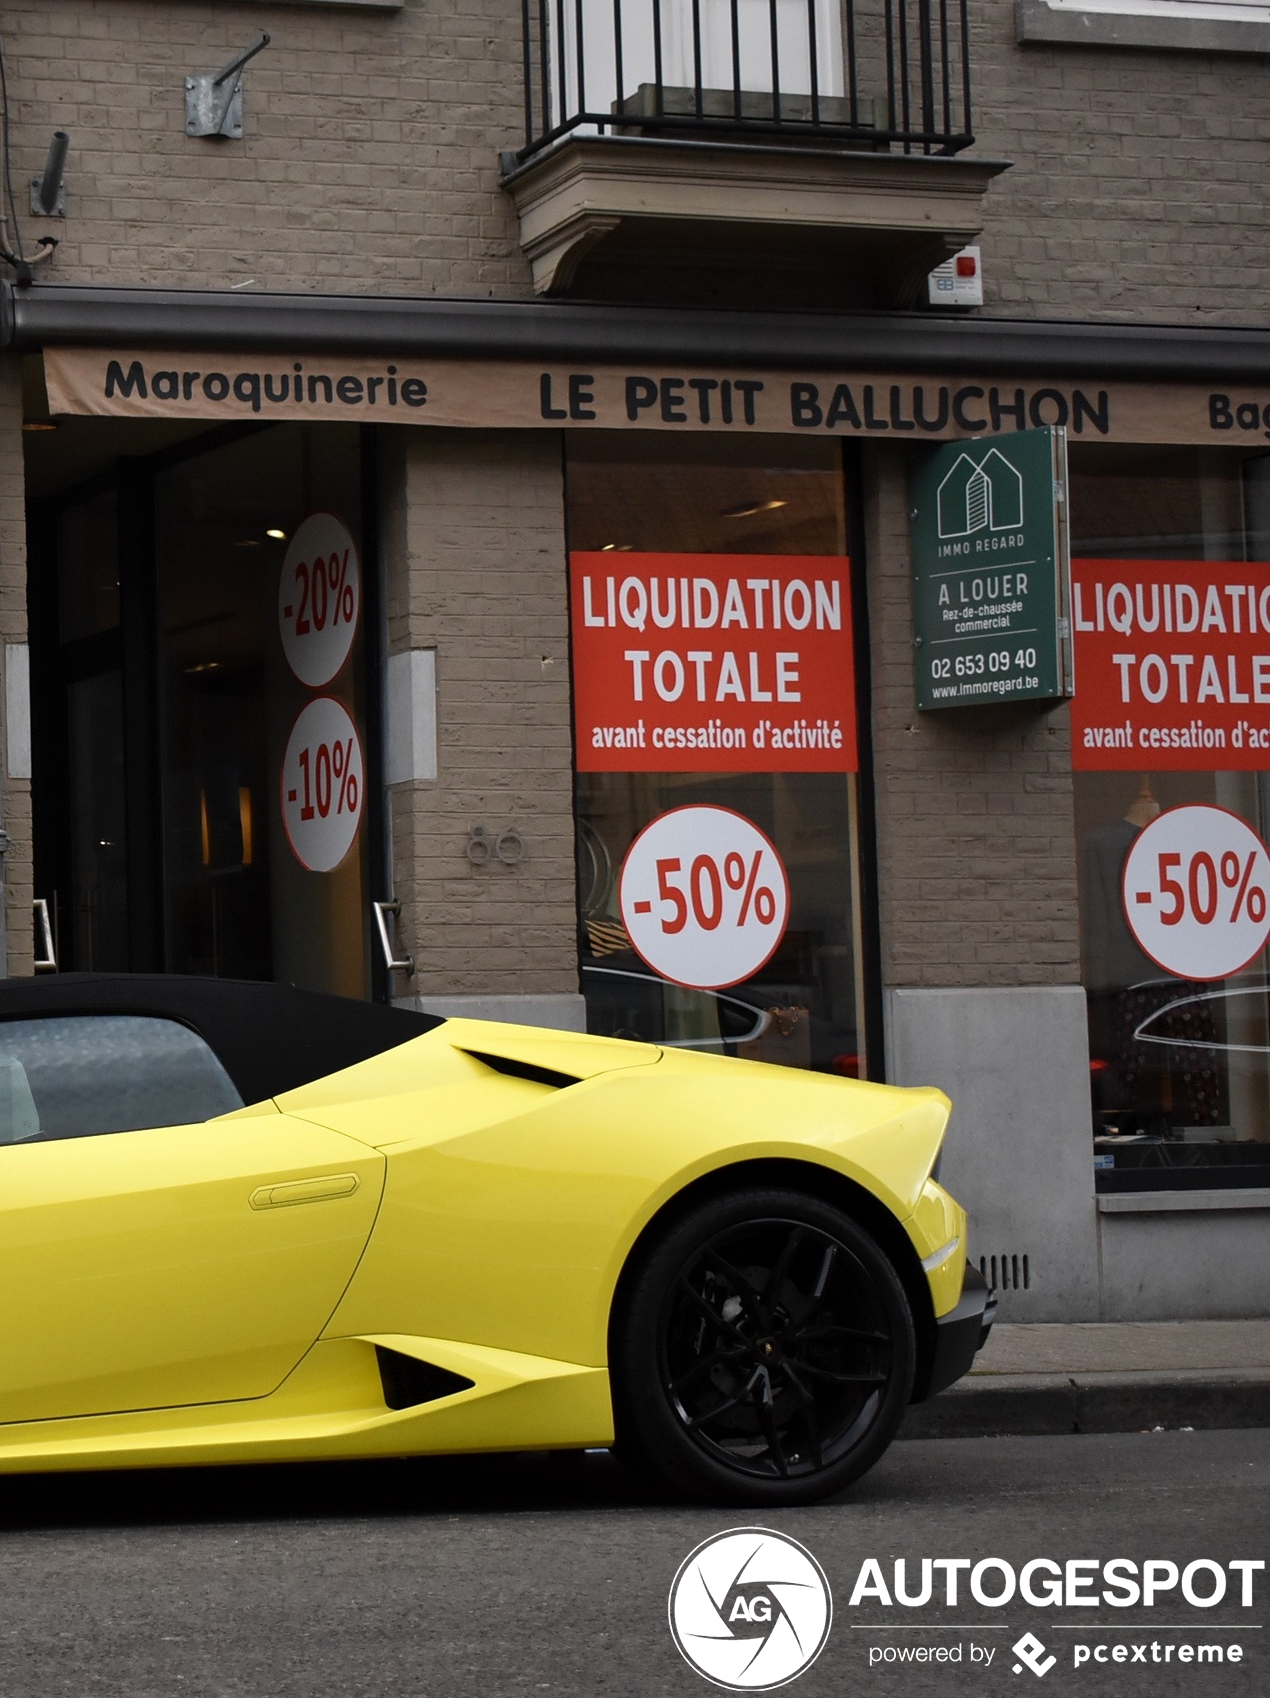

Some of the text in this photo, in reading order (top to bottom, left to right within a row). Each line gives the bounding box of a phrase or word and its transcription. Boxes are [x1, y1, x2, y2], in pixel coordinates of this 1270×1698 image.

[104, 360, 428, 412] Maroquinerie
[540, 372, 1109, 435] LE PETIT BALLUCHON
[938, 534, 1025, 558] IMMO REGARD
[283, 548, 355, 638] -20%
[582, 575, 842, 632] LIQUIDATION
[938, 573, 1029, 605] A LOUER
[942, 600, 1023, 621] Rez-de-chaussée
[955, 616, 1011, 634] commercial
[625, 650, 801, 702] TOTALE
[931, 648, 1037, 679] 02 653 09 40
[932, 675, 1039, 699] www.immoregard.be
[1112, 653, 1270, 704] TOTALE
[592, 718, 843, 750] avant cessation d'activité
[1083, 720, 1270, 749] avant cessation d'ac
[287, 738, 358, 821] -10%
[466, 824, 525, 867] 86
[633, 850, 777, 935] -50%
[1136, 850, 1266, 926] -50%
